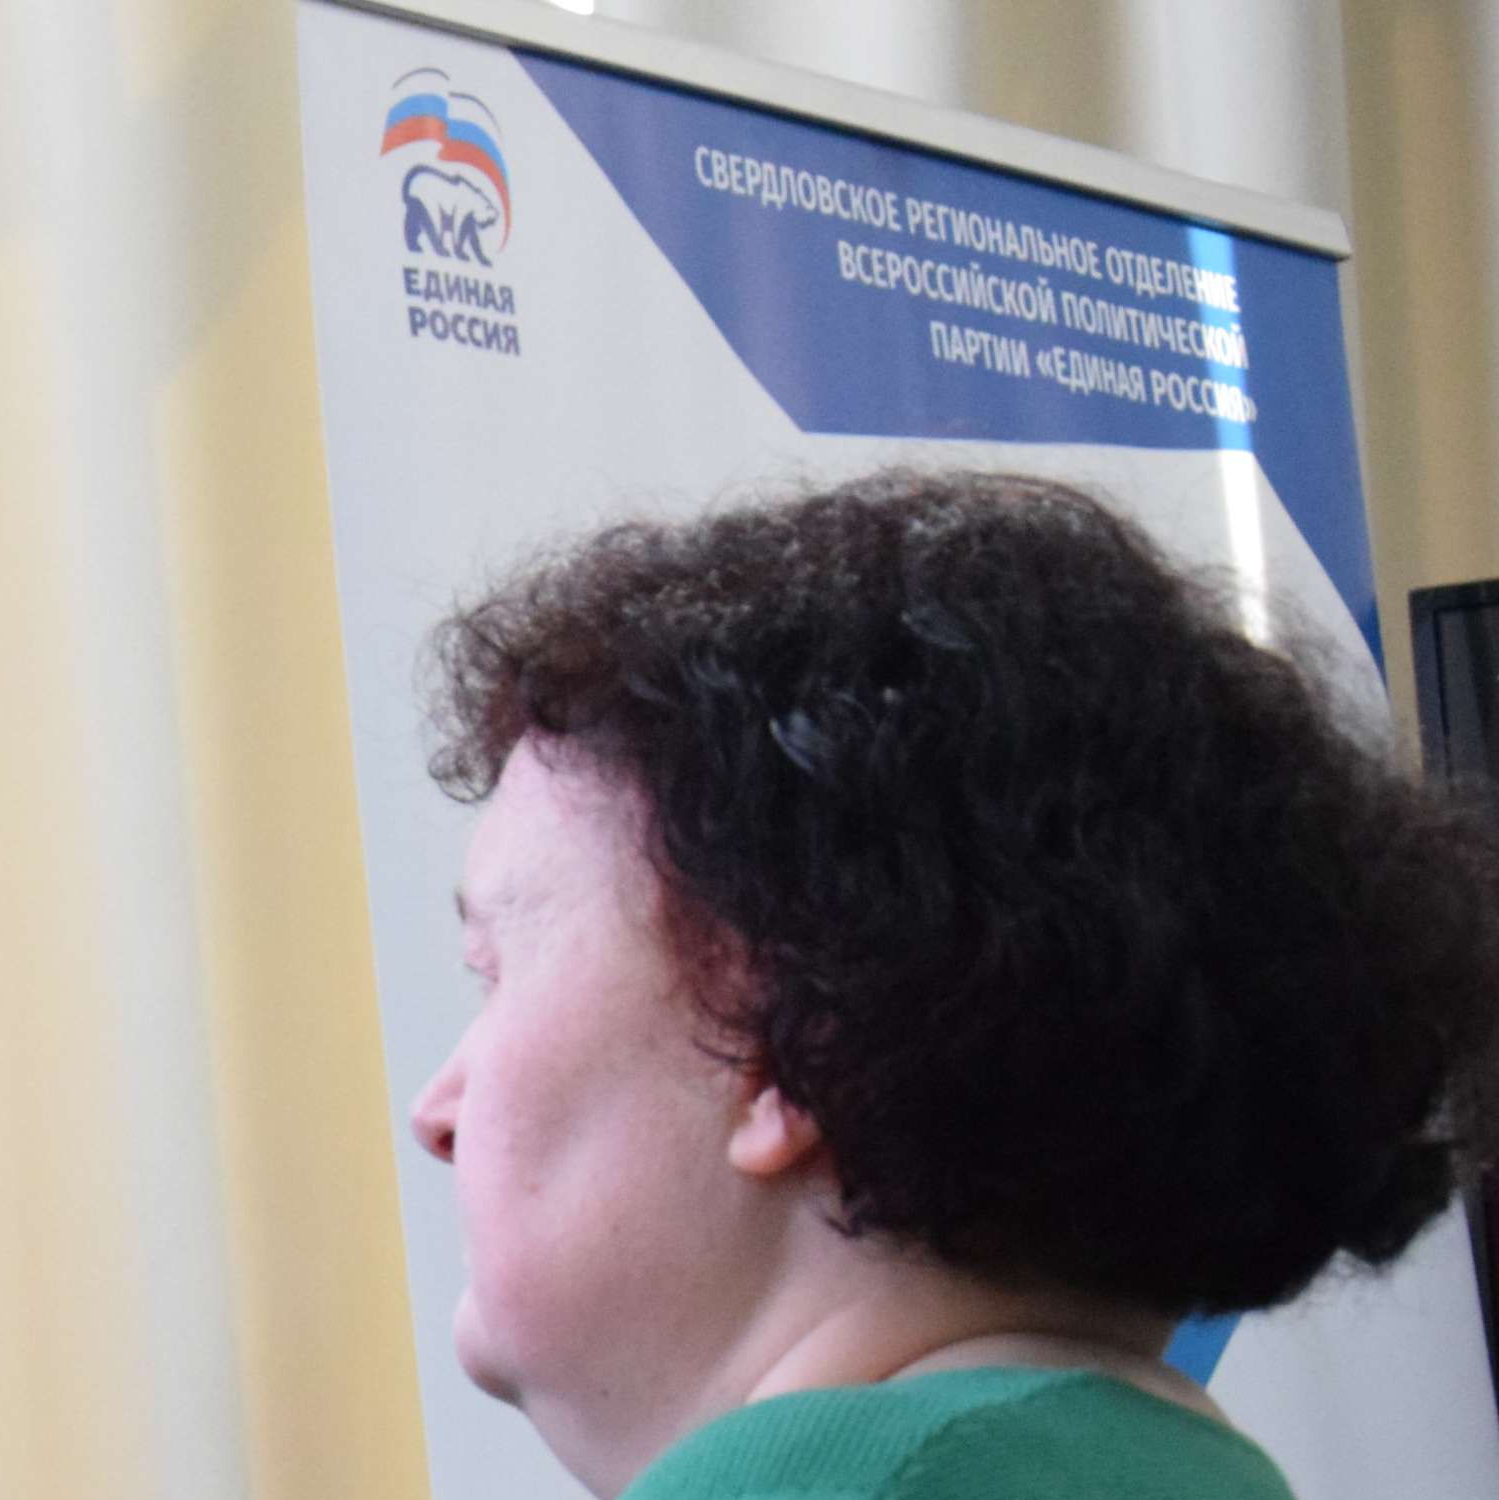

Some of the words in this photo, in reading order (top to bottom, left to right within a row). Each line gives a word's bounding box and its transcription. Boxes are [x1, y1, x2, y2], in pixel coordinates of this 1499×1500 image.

[694, 145, 903, 234] СВЕРДЛОВСКОЕ
[905, 197, 1104, 280] РЕГИОНАЛЬНОЕ
[1105, 247, 1242, 314] ОТДЕЛЕНИЕ
[402, 266, 517, 316] ЕДИНАЯ
[836, 240, 1059, 326] ВСЕРОССИЙСКОЙ
[1061, 289, 1249, 370] ПОЛИТИЧЕСКОЙ
[407, 305, 522, 357] РОССИЯ
[929, 319, 1031, 379] ПАРТИИ
